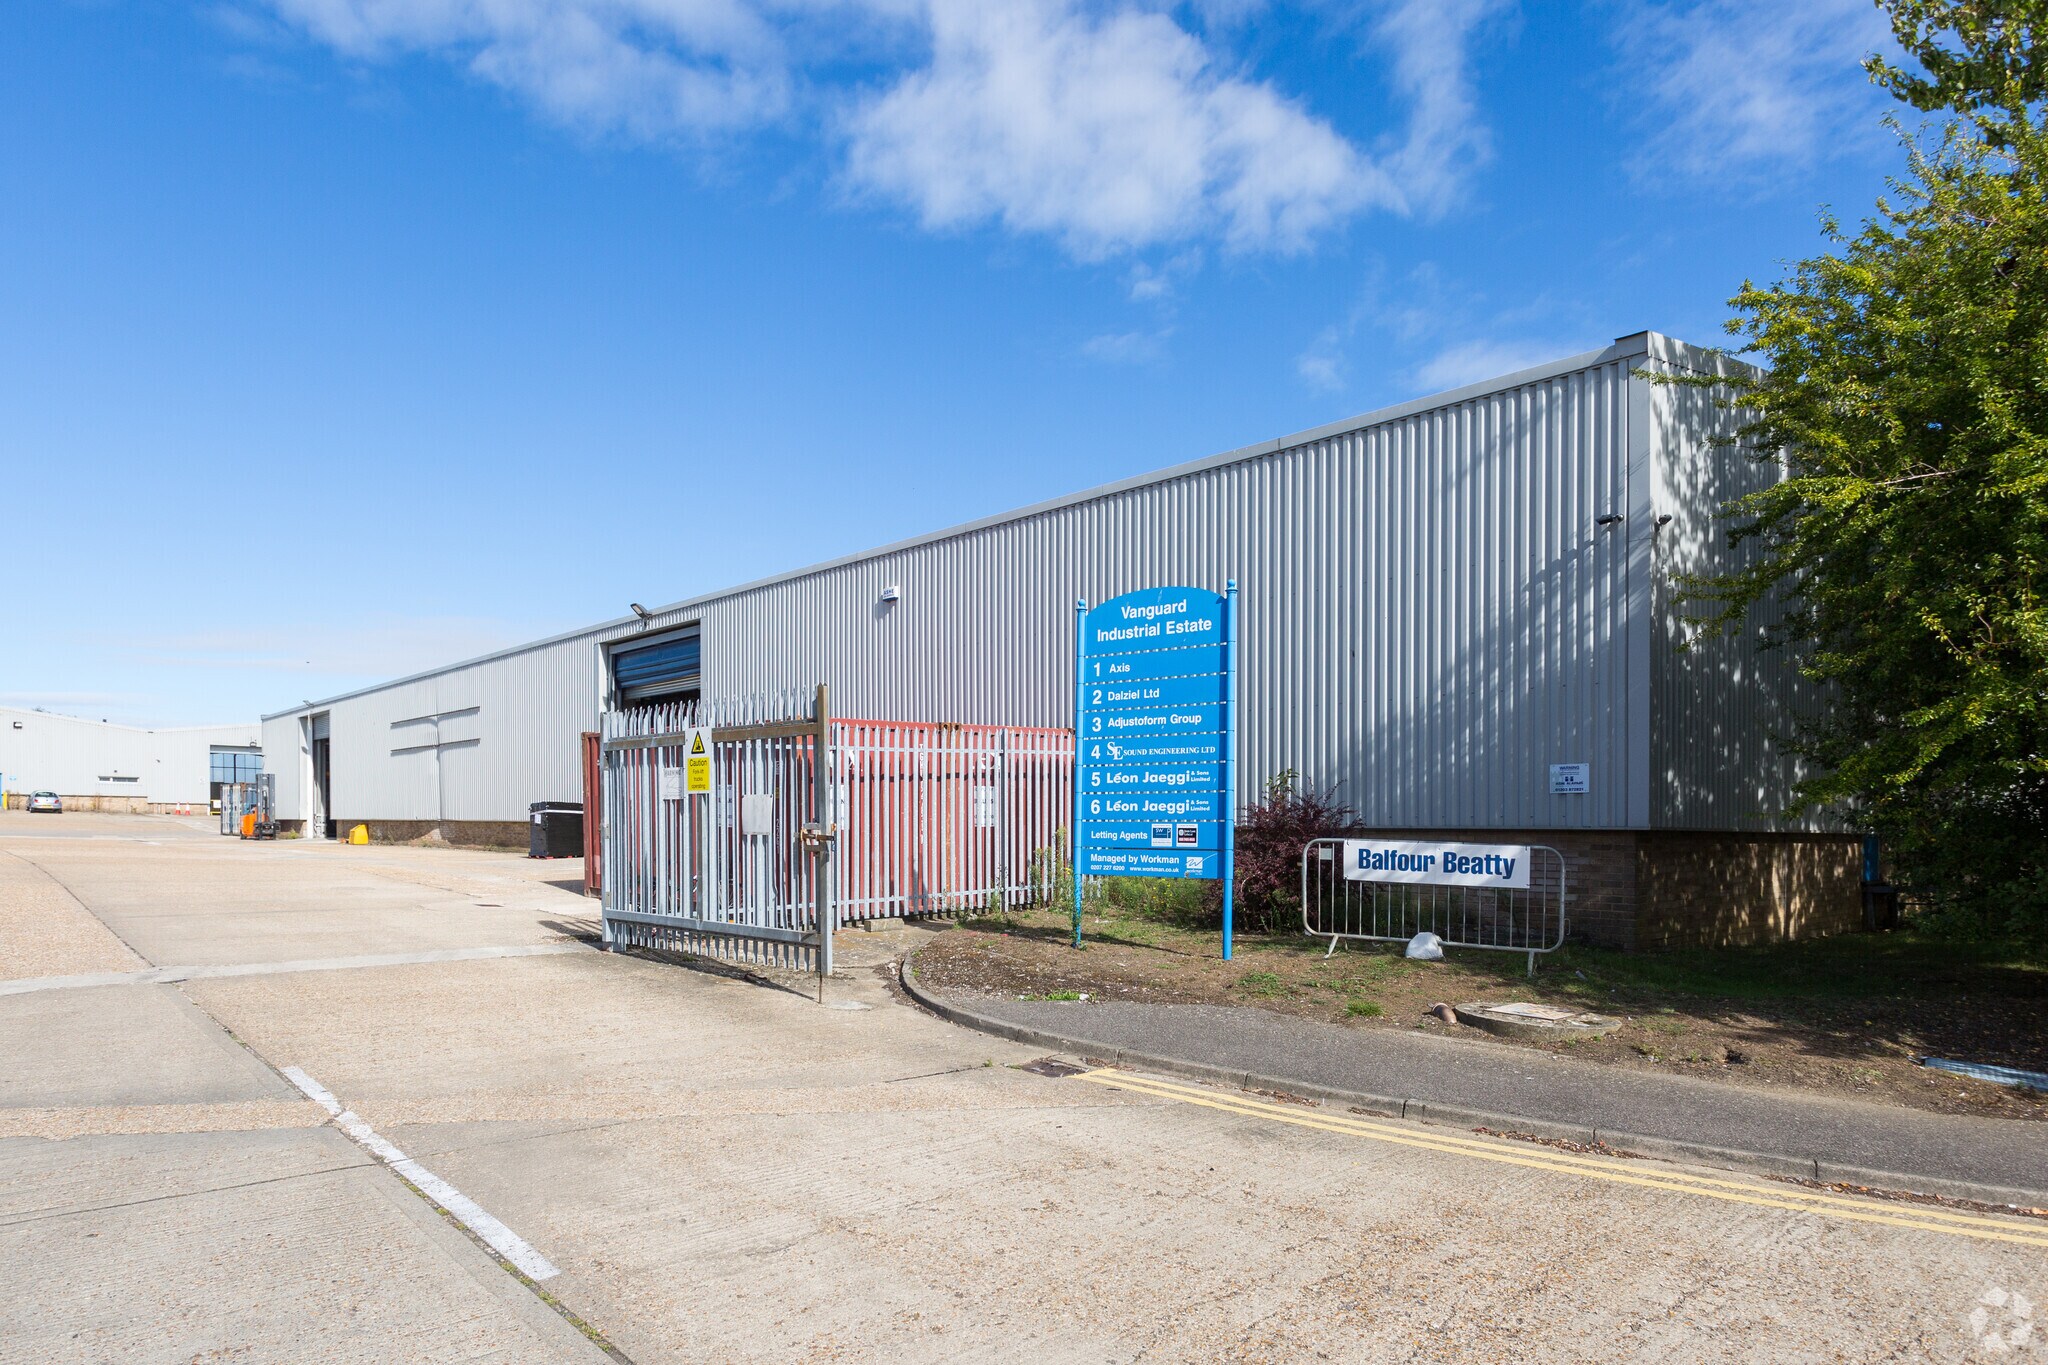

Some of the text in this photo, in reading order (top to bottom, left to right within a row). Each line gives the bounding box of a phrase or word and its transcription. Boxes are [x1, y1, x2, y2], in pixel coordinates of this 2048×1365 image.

[1121, 599, 1187, 620] Vanguard
[1097, 618, 1212, 642] Industrial Estate
[1093, 662, 1131, 677] 1 Axis
[1092, 688, 1160, 705] 2 Dalziel Ltd
[1092, 714, 1202, 732] 3 Adjustoform Group
[1090, 744, 1101, 759] 4
[1149, 746, 1200, 756] ENGINEERING
[1200, 746, 1216, 754] LTD
[690, 758, 707, 767] Caution
[1091, 770, 1190, 787] 5 Léon Jaeggi
[1090, 799, 1190, 815] 6 Léon Jaeggi
[1091, 830, 1148, 842] Letting Agents
[1090, 853, 1180, 865] Managed by Workman
[1358, 848, 1516, 880] Balfour Beatty
